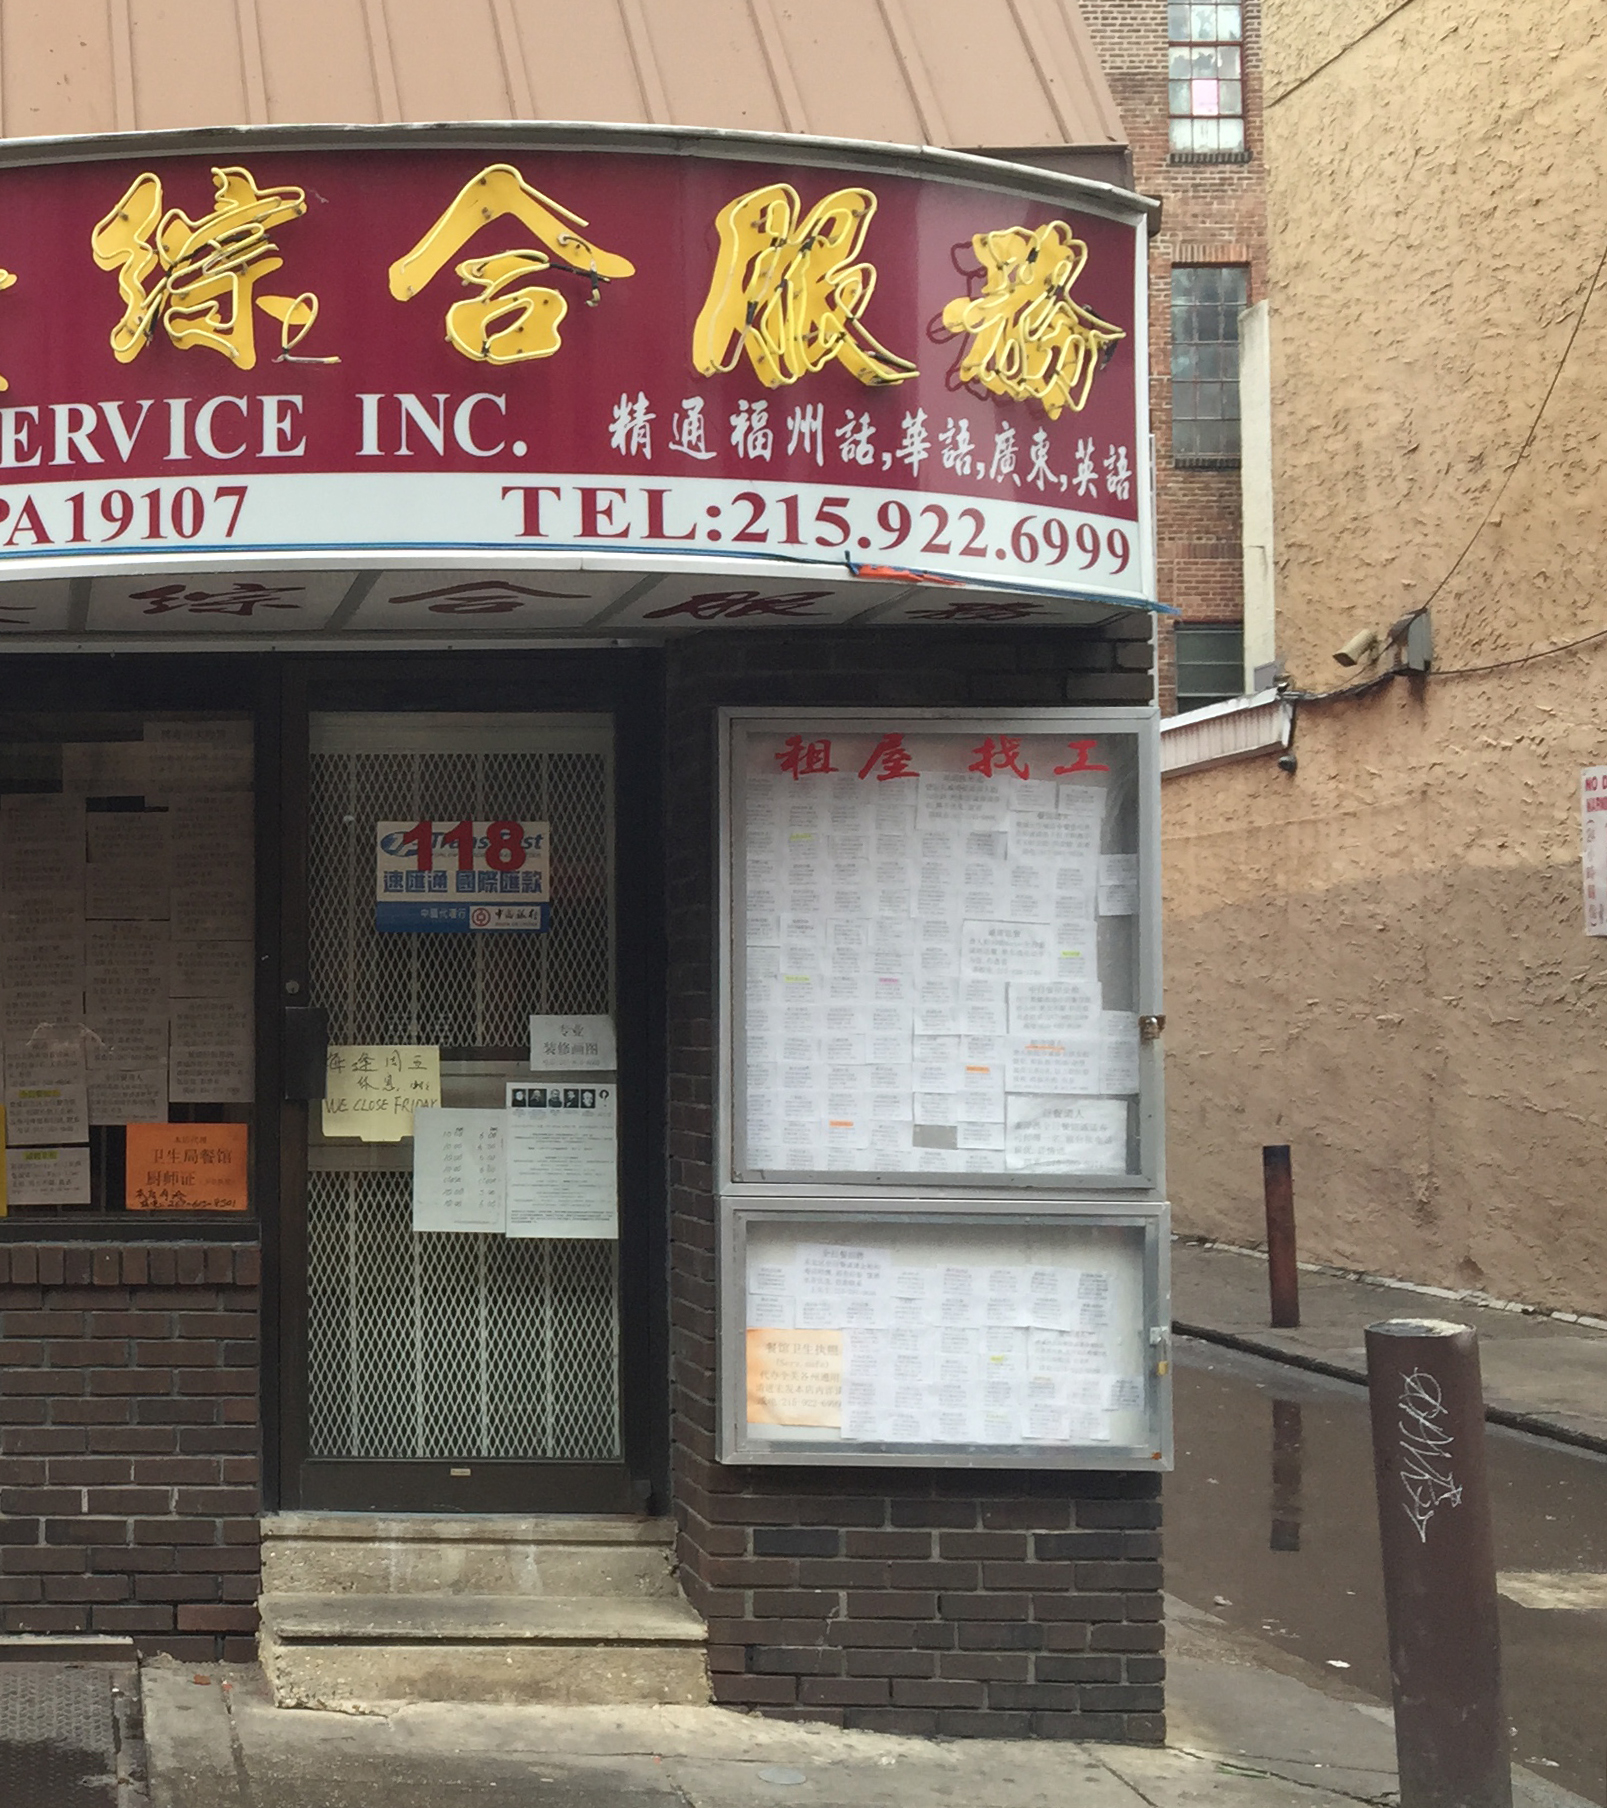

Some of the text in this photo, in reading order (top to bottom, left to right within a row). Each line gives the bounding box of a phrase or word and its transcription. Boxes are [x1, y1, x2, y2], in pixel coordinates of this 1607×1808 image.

[354, 391, 529, 459] INC.
[500, 485, 1131, 576] TEL:215.922.6999
[403, 820, 527, 872] 118
[325, 1098, 349, 1113] WE
[353, 1098, 389, 1112] CLOSE
